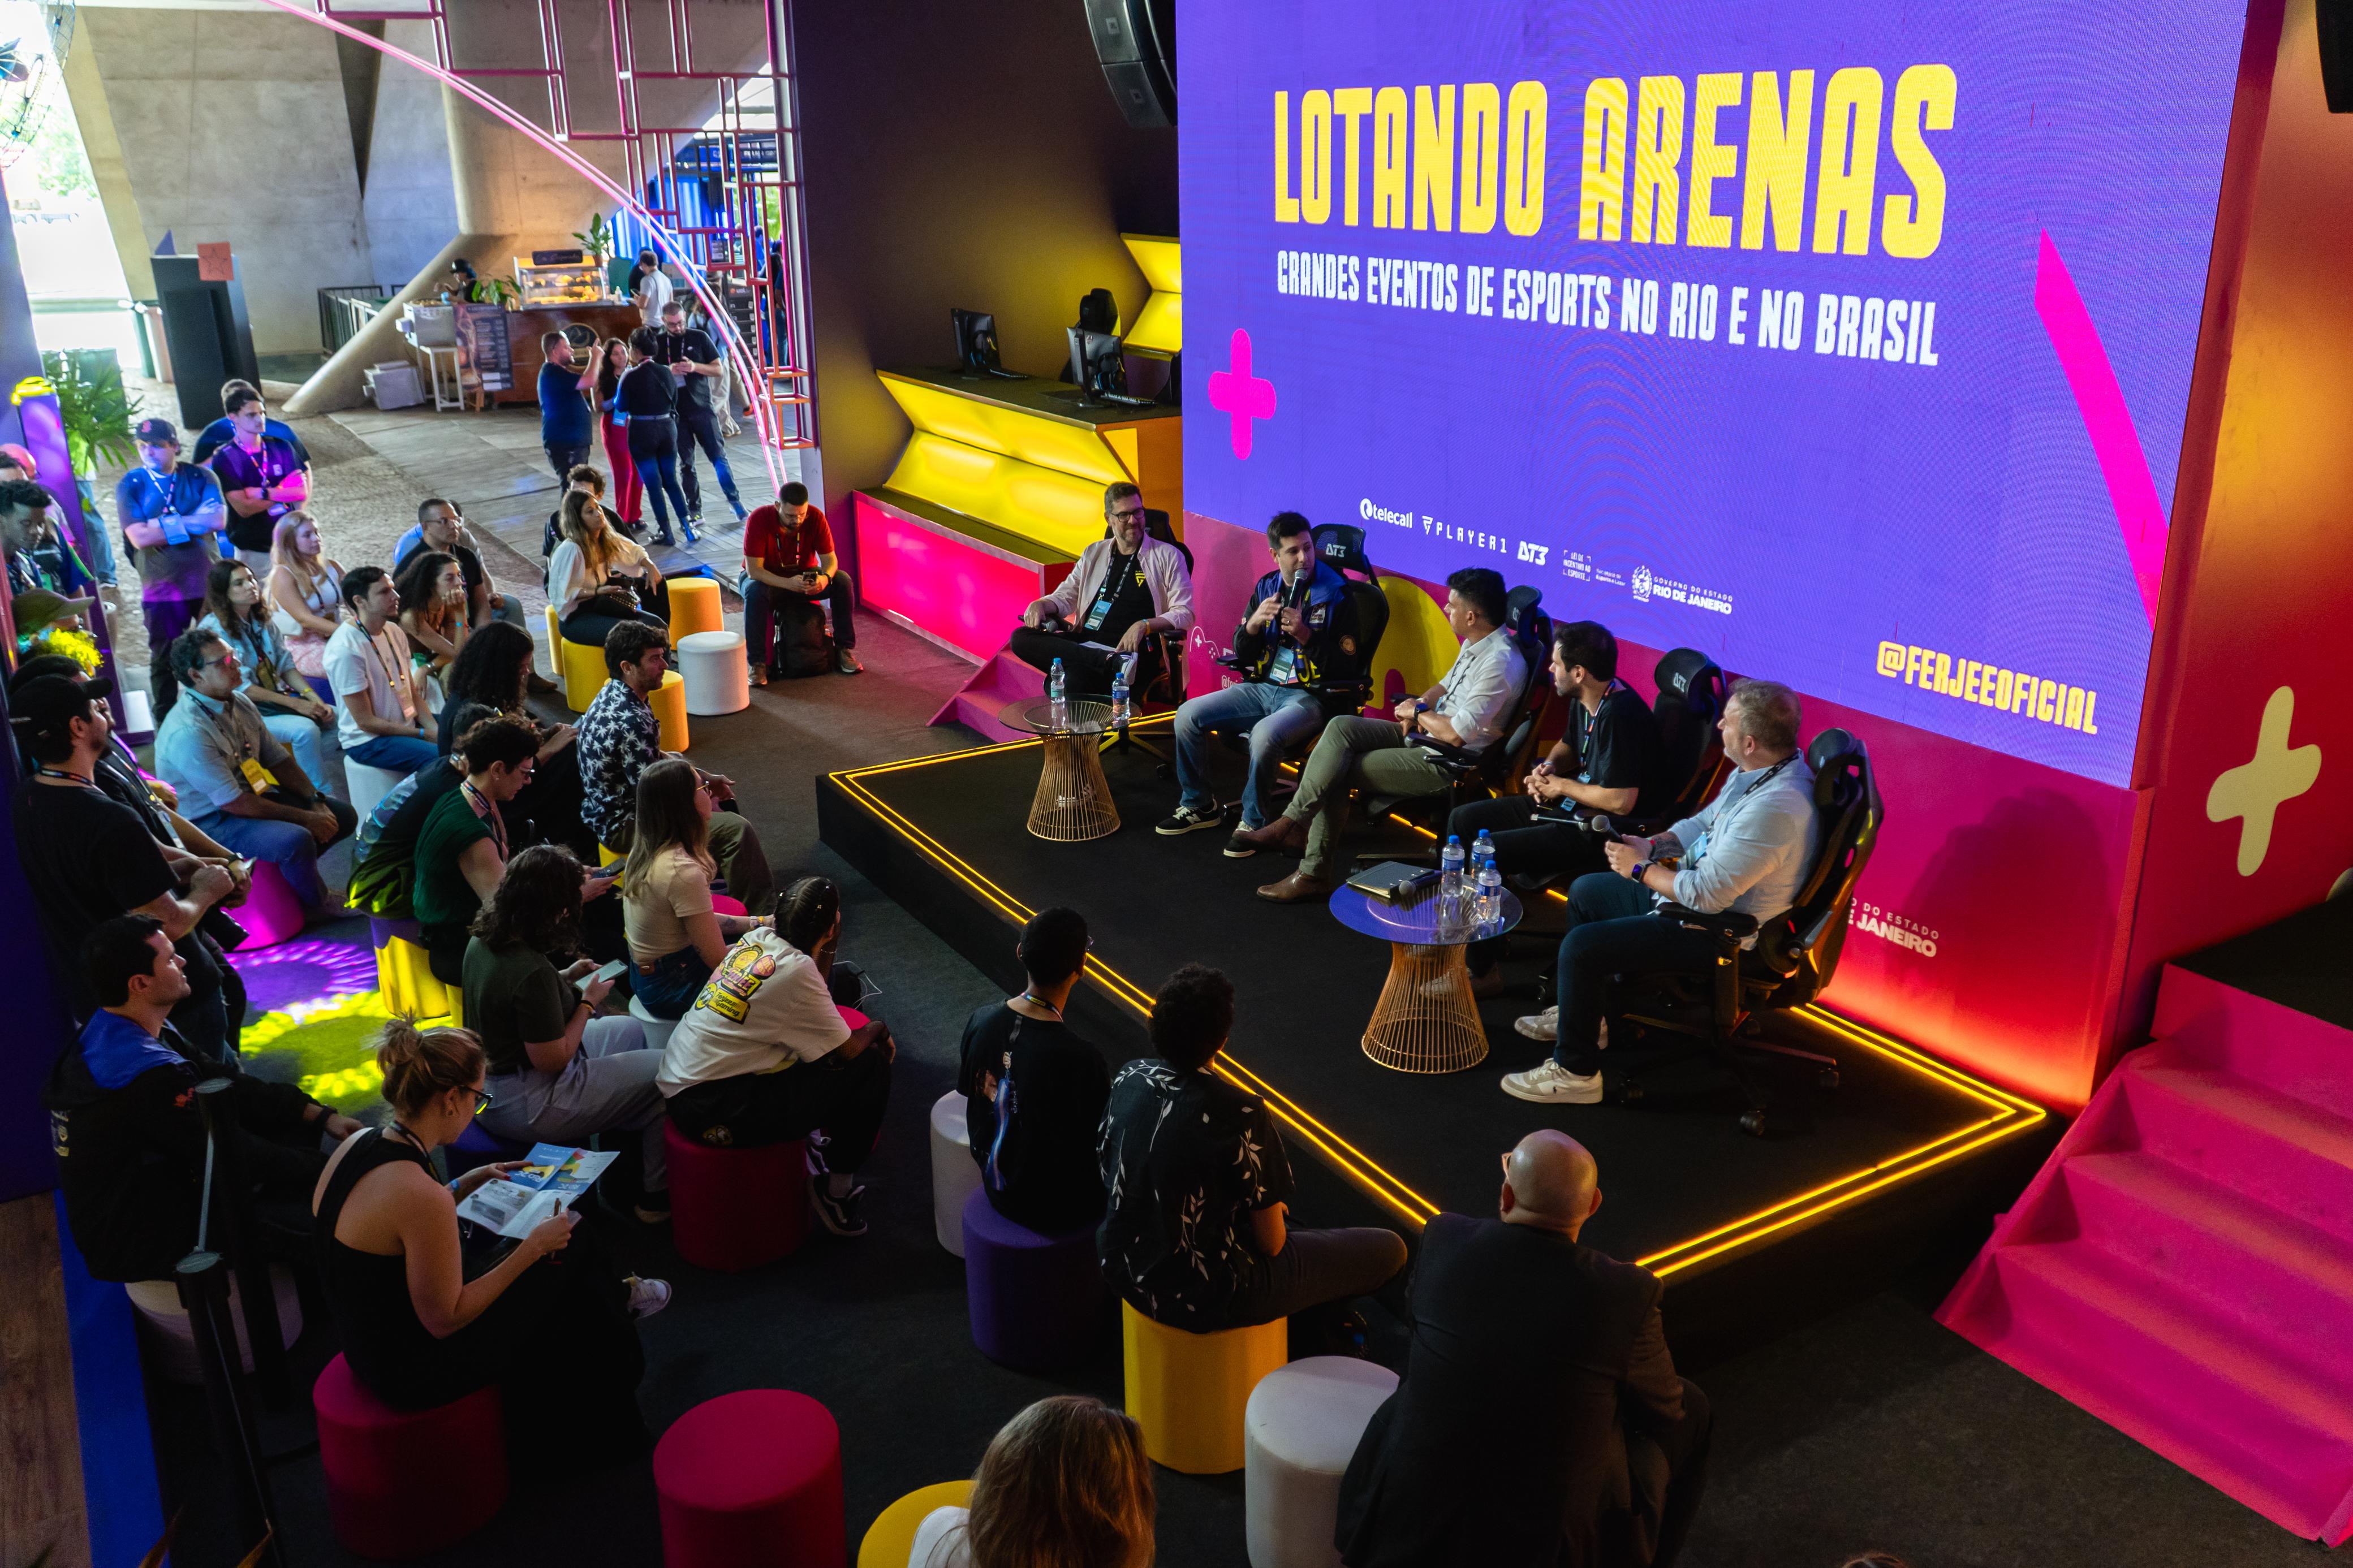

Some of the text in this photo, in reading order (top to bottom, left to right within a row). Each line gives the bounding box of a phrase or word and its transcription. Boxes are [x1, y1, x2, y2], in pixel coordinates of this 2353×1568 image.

[1275, 63, 1958, 259] LOTANDO ARENAS
[1277, 250, 1938, 366] GRANDES EVENTOS DE ESPORTS NO RIO E NO BRASIL
[1373, 504, 1413, 529] telecall
[1517, 541, 1549, 566] DT3
[1653, 576, 1734, 603] GOVERNO DO ESTADO
[1653, 584, 1733, 615] RIO DE JANEIRO
[1877, 641, 2098, 735] @FERJEEOFICIAL
[1856, 913, 1937, 957] JANEIRO
[1863, 902, 1939, 940] DO ESTADO
